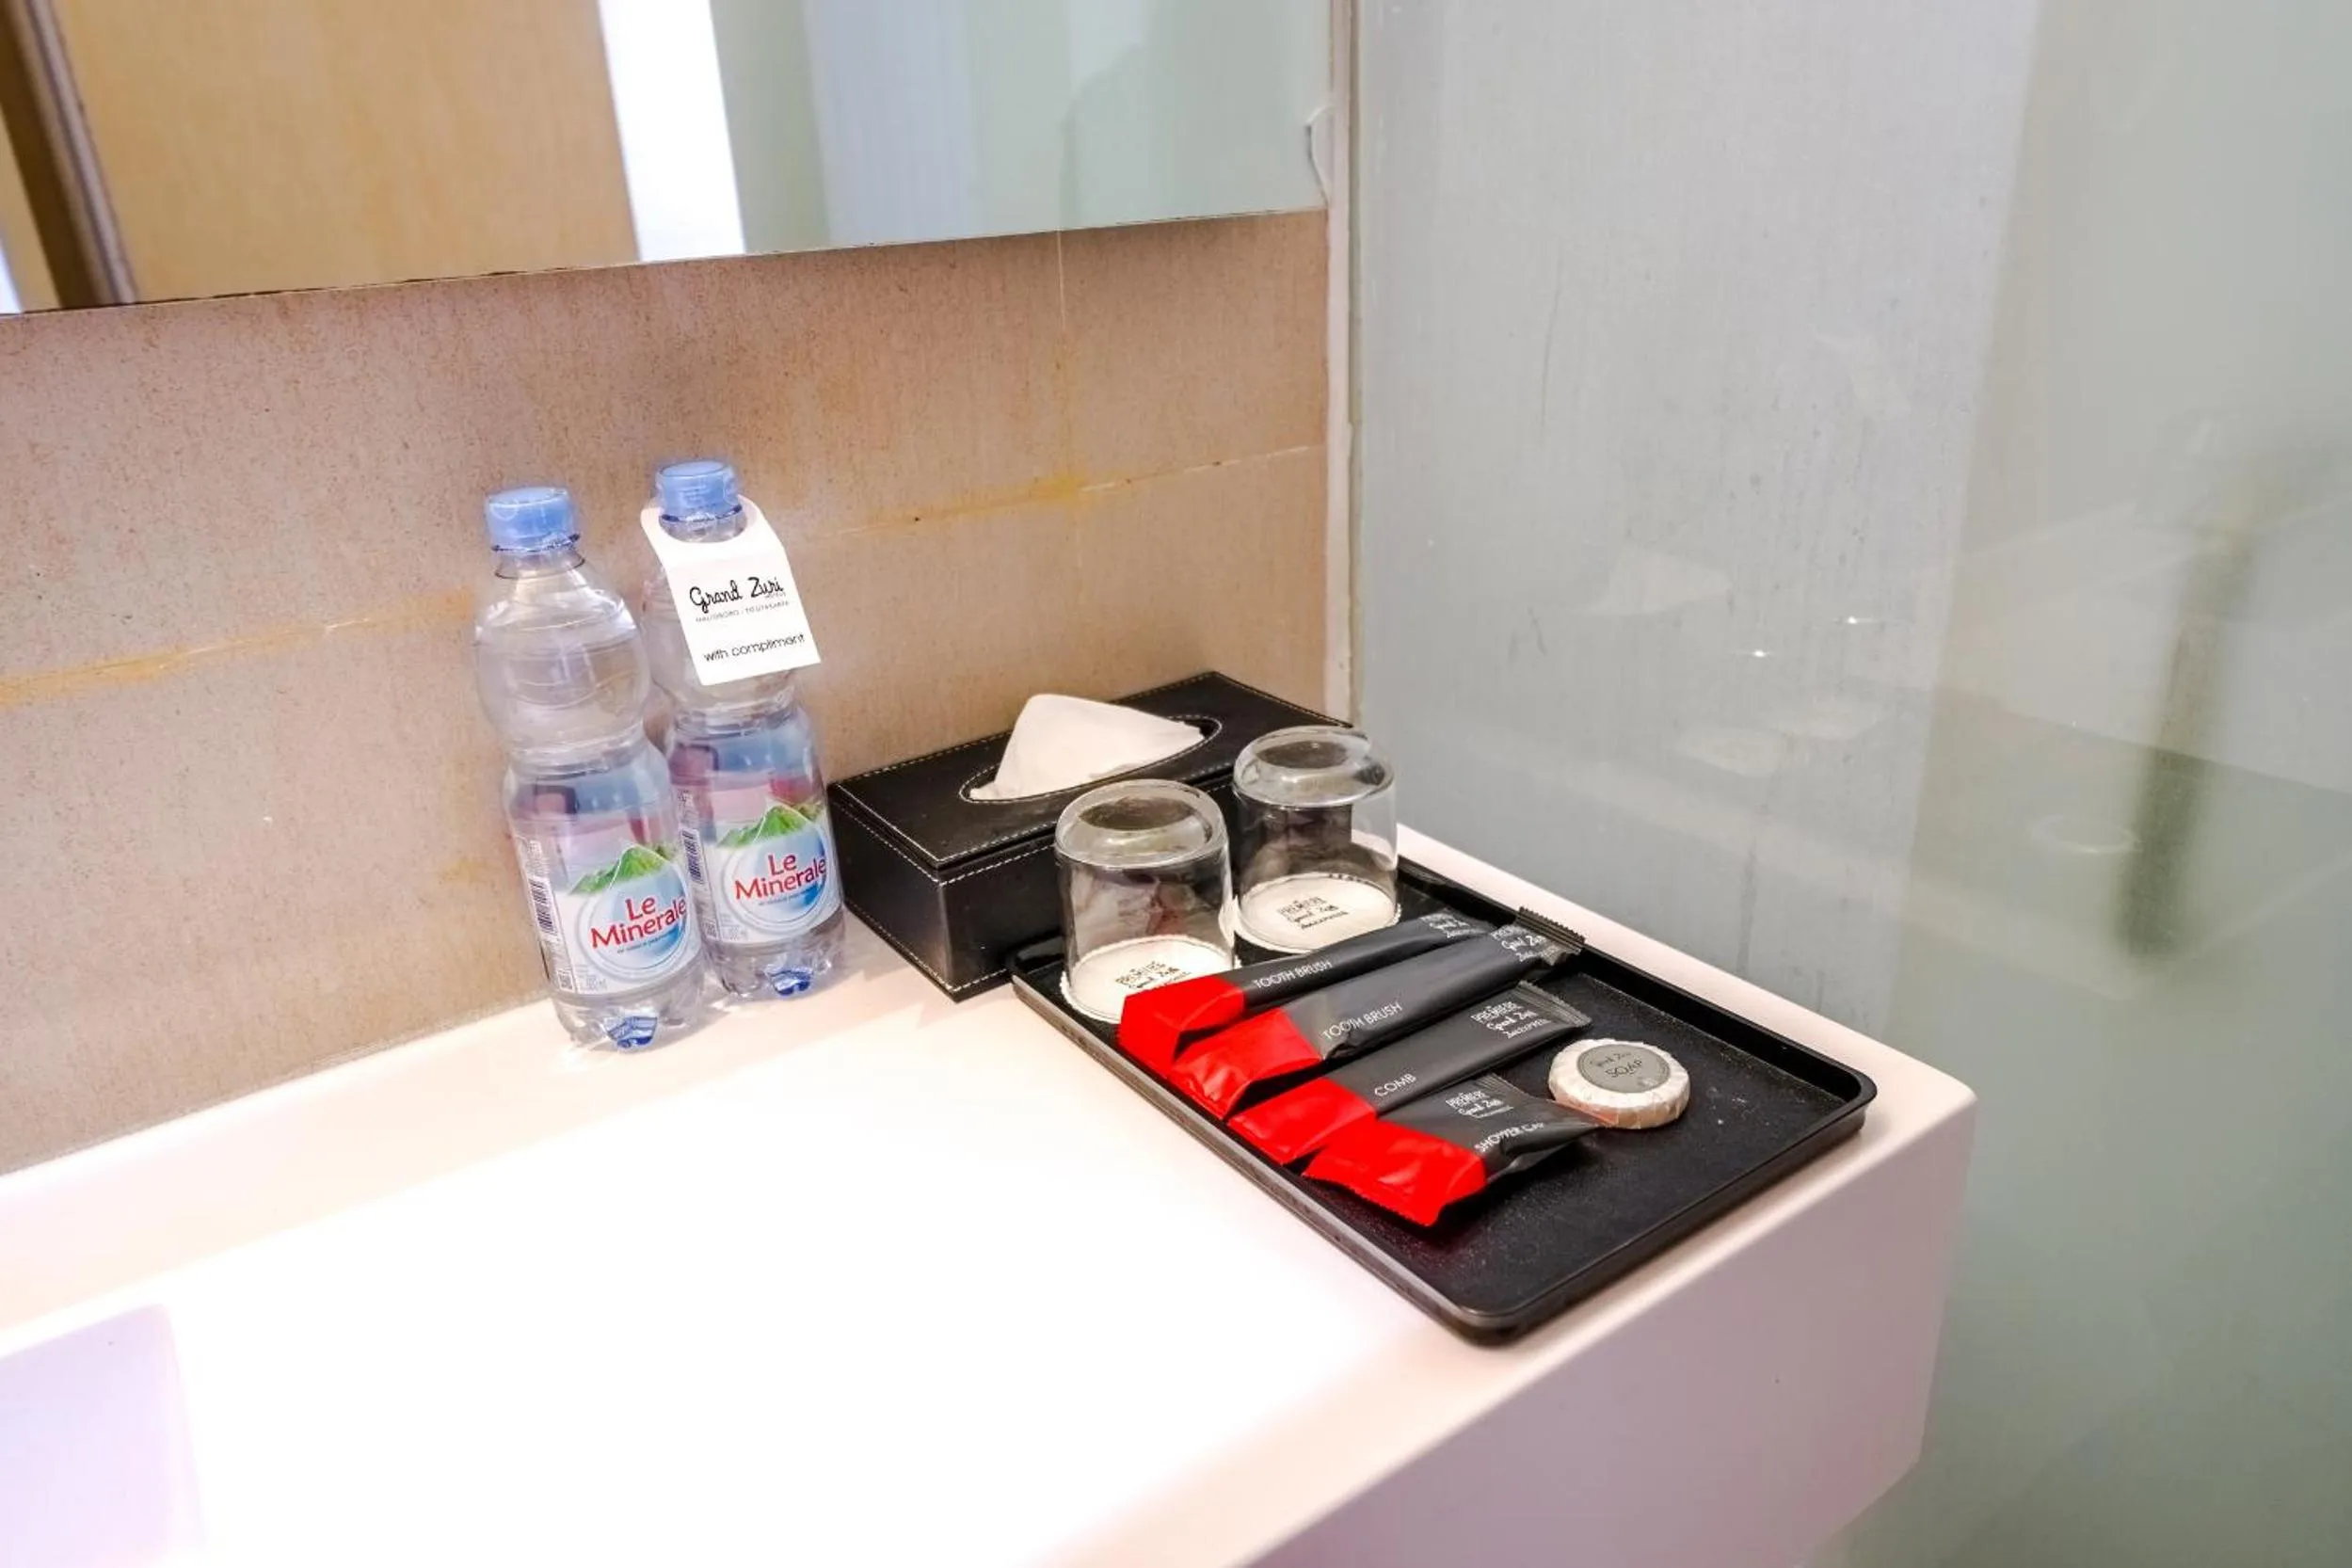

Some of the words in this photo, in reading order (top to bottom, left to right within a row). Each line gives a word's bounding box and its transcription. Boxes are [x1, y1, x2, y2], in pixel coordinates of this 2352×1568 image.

[689, 579, 744, 614] Grand
[747, 576, 784, 598] Zuri
[704, 648, 728, 662] with
[731, 633, 804, 656] compliment
[734, 857, 827, 900] Minerale
[768, 854, 797, 876] Le
[590, 897, 686, 949] Minerale
[625, 896, 656, 921] Le
[1254, 970, 1296, 989] TOOTH
[1294, 960, 1333, 977] BRUSH
[1321, 1017, 1365, 1040] TOOTH
[1363, 1001, 1403, 1025] BRUSH
[1374, 1073, 1417, 1097] COMB
[1474, 1128, 1523, 1153] SHOWER
